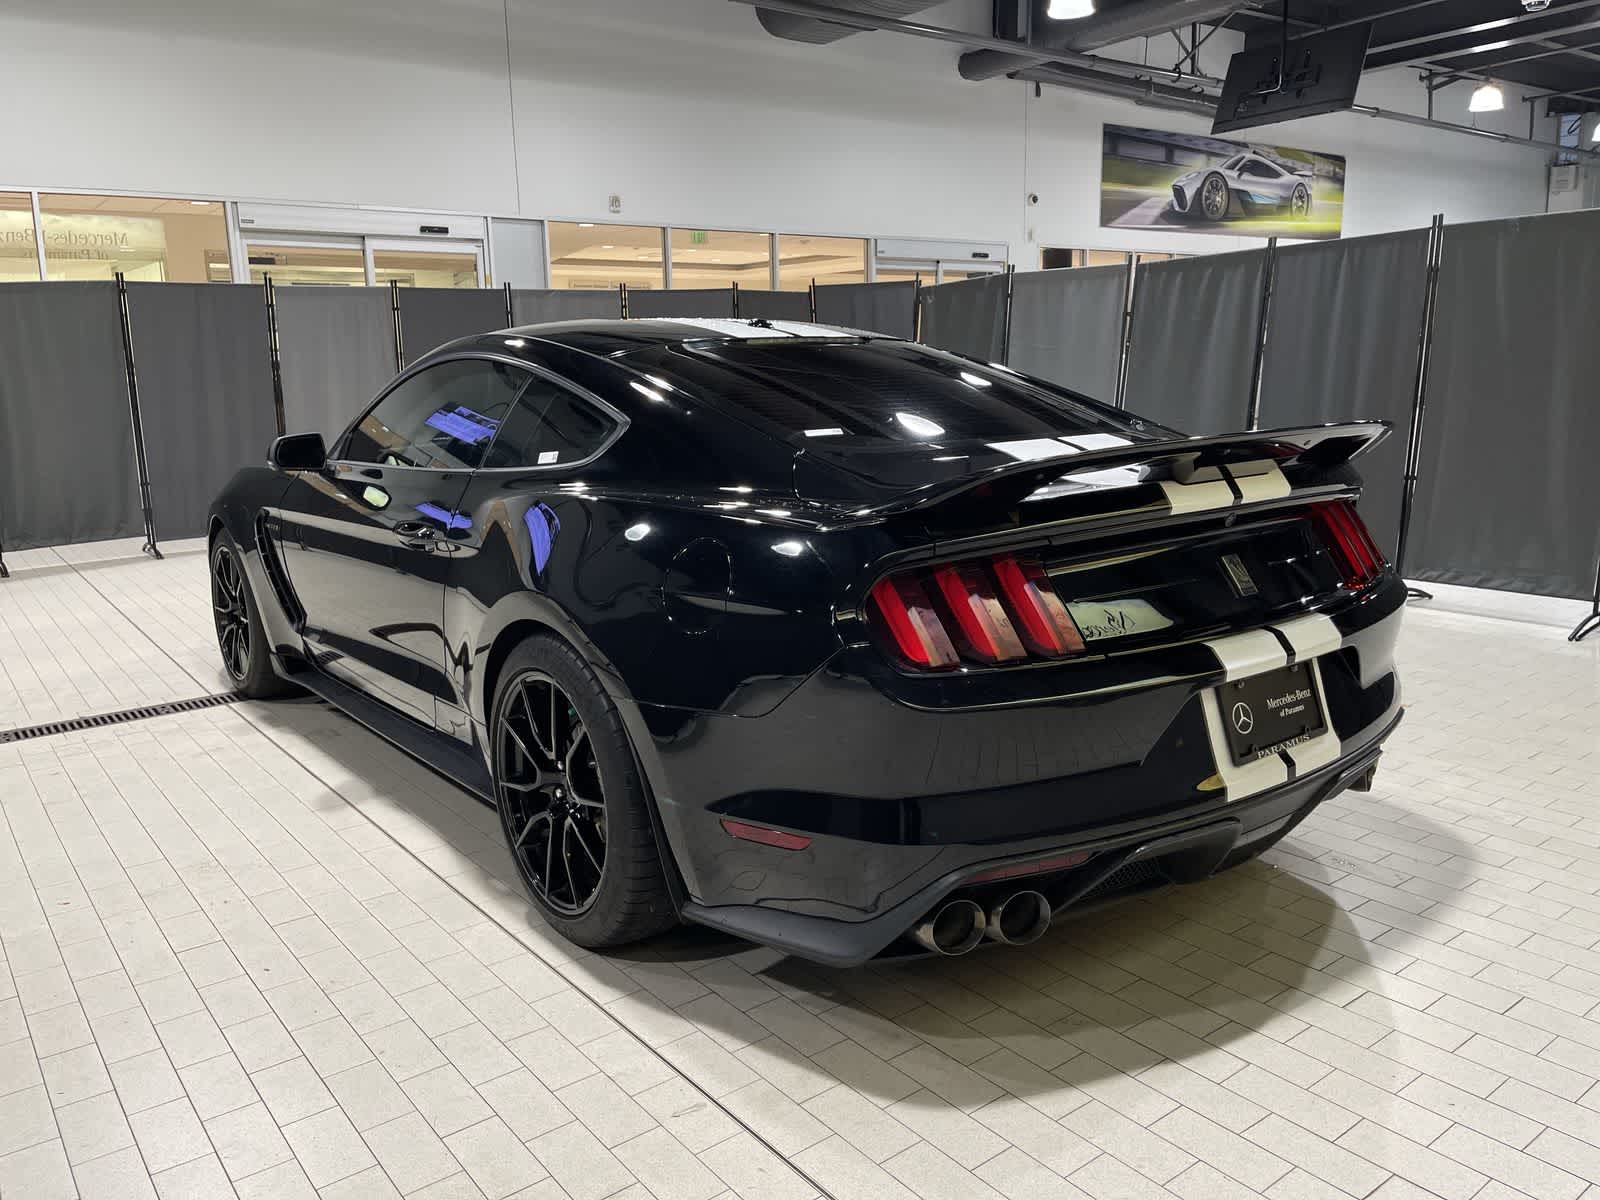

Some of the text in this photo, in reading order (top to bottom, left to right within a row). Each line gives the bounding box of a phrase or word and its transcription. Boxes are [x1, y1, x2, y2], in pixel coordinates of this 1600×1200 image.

[1266, 688, 1312, 710] Mercedes-Benz
[1285, 704, 1305, 716] Paramus
[1257, 734, 1311, 759] PARAMUS
